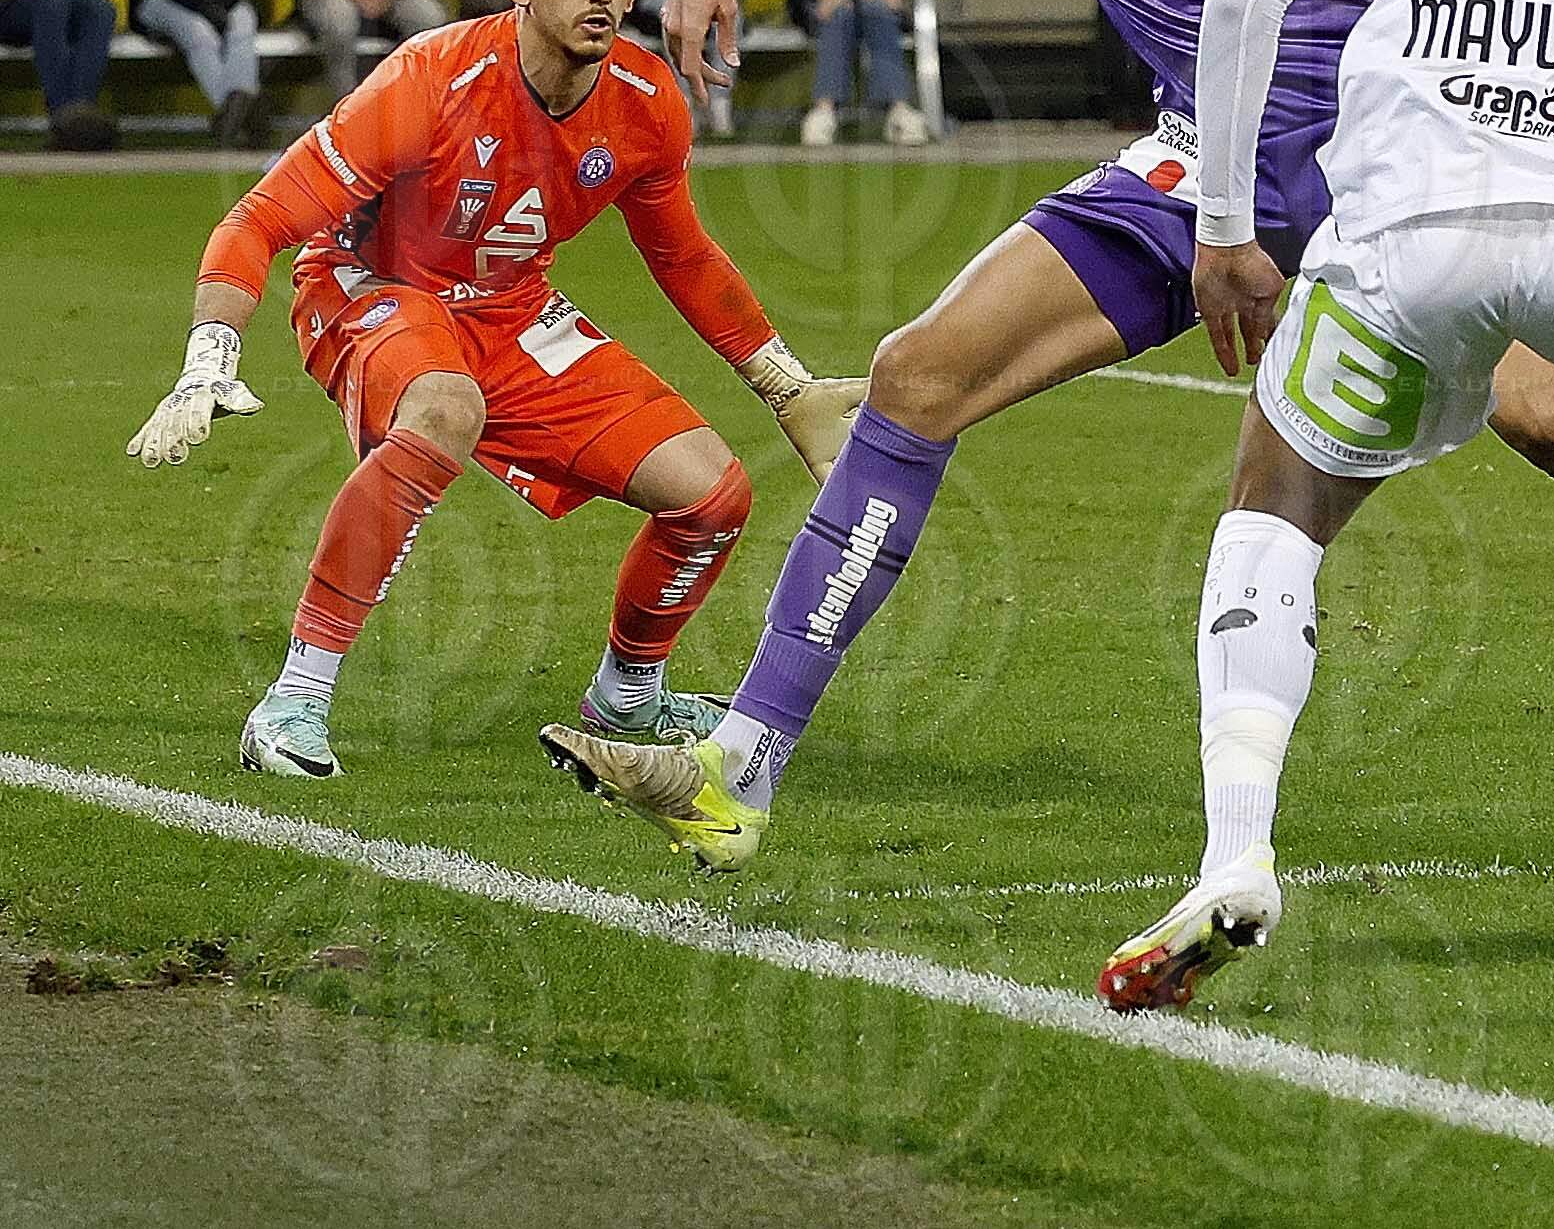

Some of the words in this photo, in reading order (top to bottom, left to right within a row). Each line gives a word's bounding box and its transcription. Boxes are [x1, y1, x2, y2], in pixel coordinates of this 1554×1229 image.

[1468, 110, 1509, 128] SOFT
[1275, 396, 1319, 441] ENERGIE
[804, 496, 899, 646] wienholding
